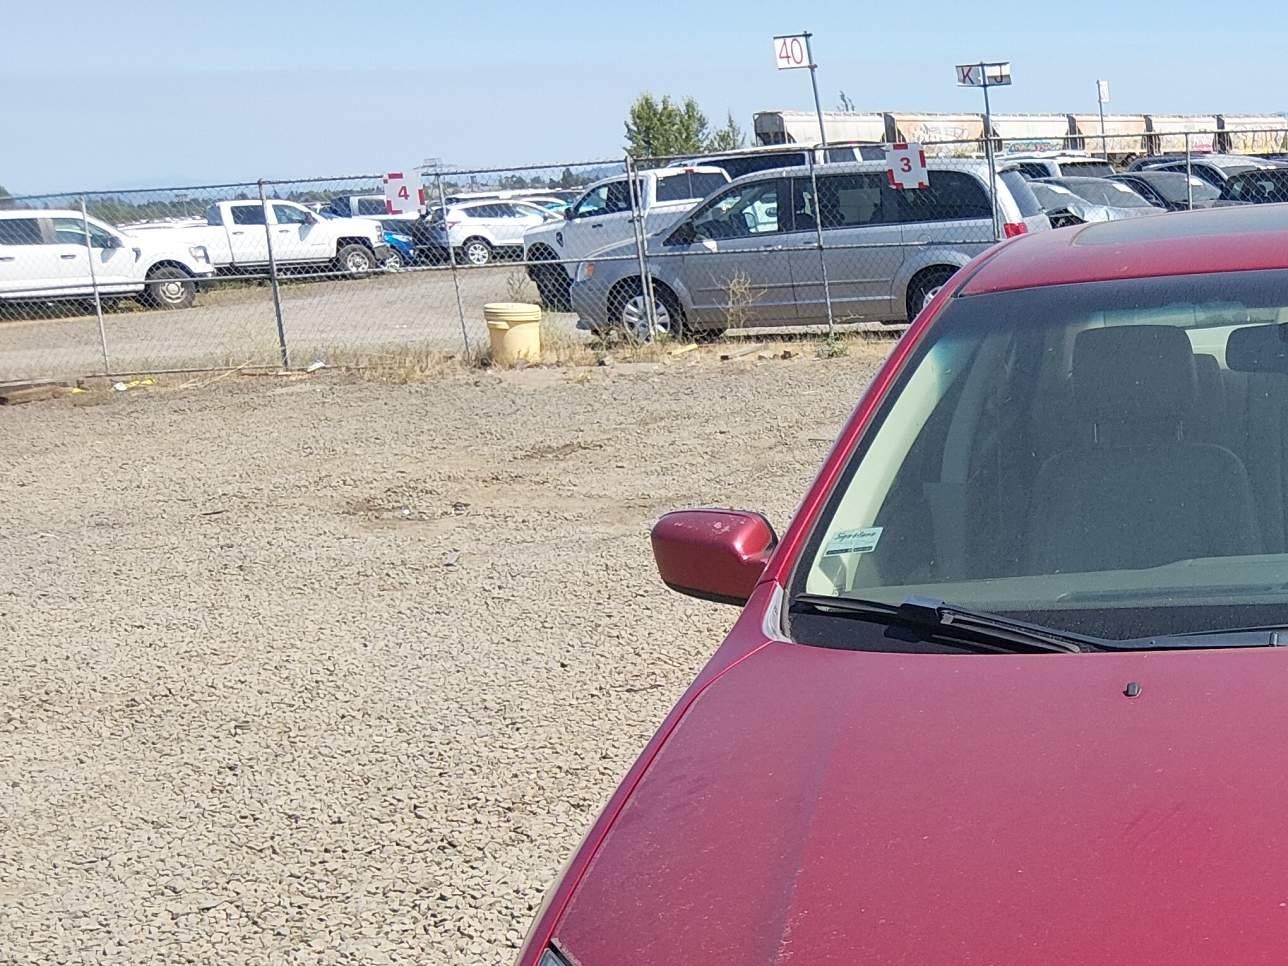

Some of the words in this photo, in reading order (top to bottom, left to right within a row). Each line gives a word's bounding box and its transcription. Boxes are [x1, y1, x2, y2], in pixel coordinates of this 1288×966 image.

[779, 38, 803, 65] 40
[961, 67, 973, 84] K
[899, 157, 911, 172] 3
[398, 185, 409, 201] 4
